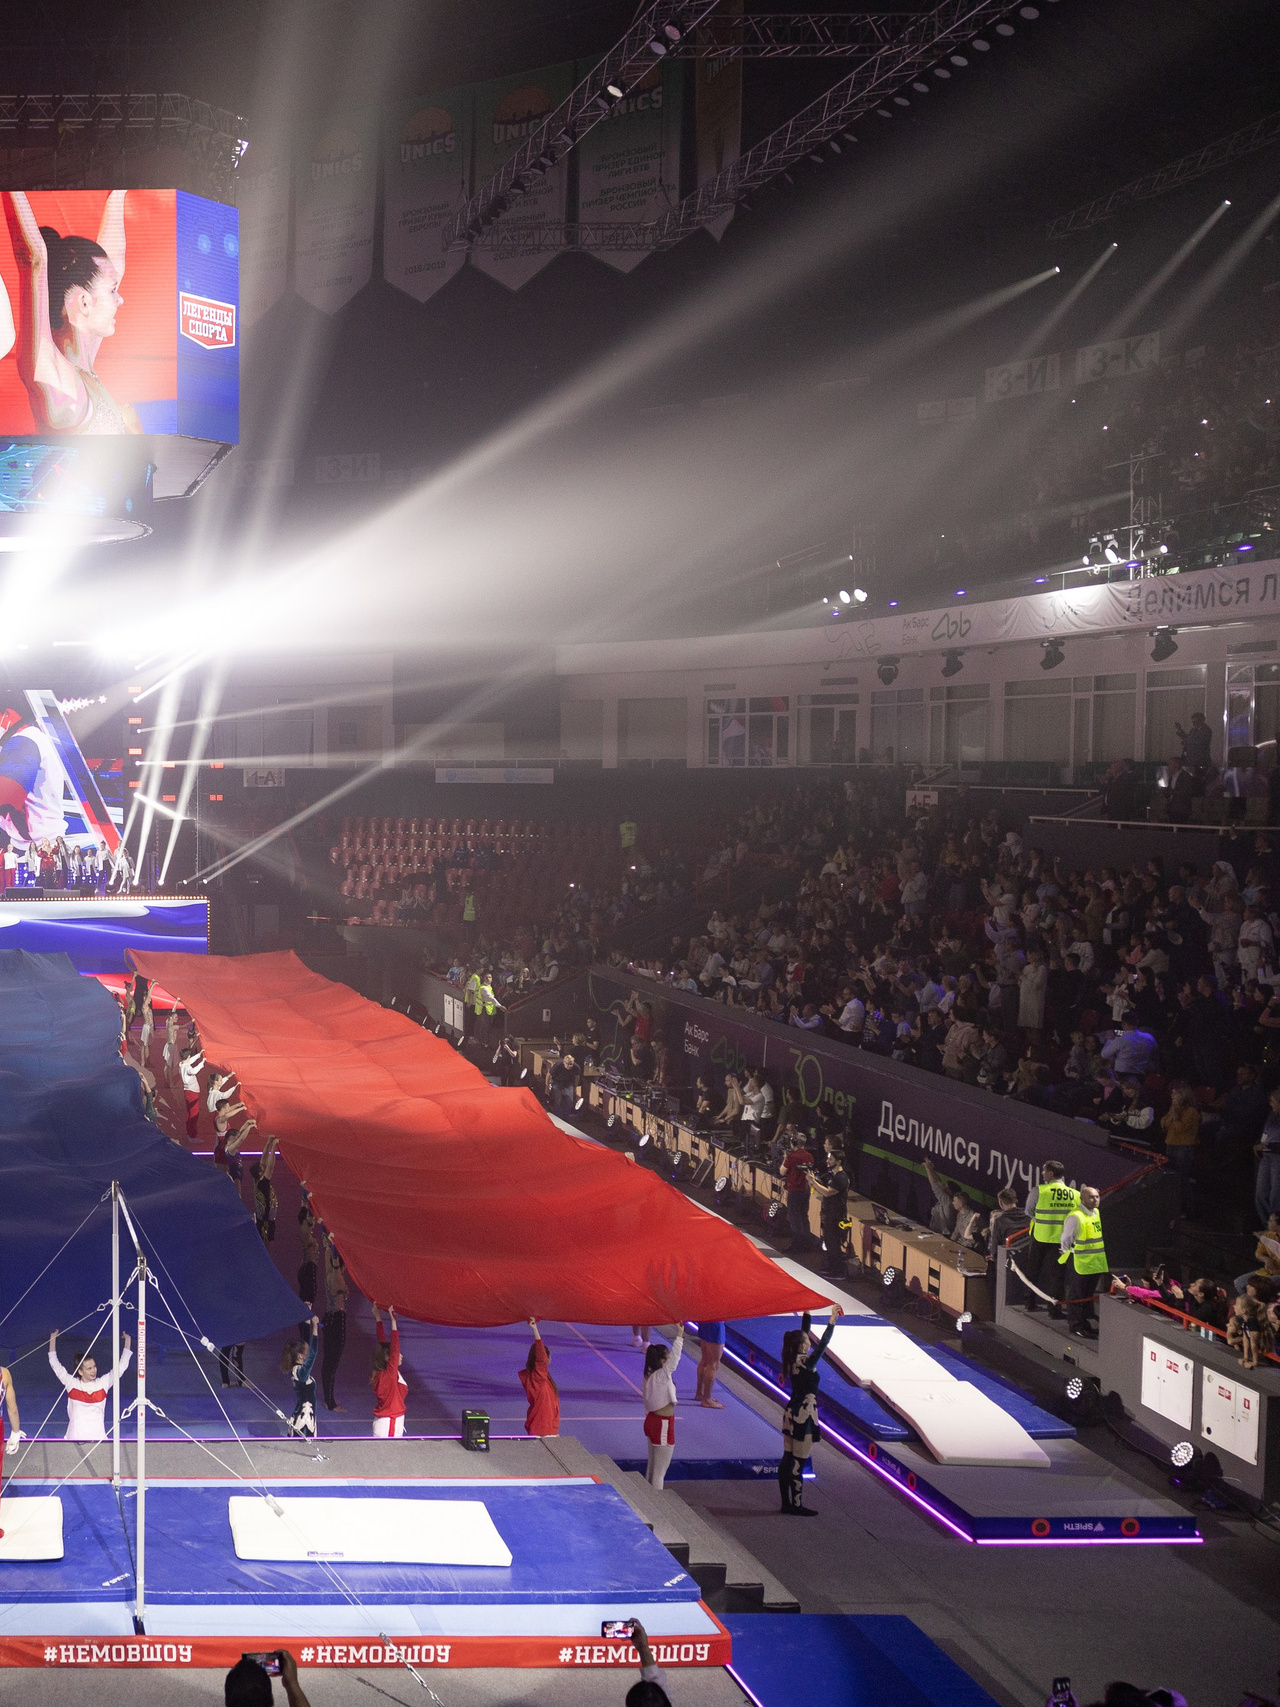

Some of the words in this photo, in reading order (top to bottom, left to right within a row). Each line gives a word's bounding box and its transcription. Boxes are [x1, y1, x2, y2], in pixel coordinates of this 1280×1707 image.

[601, 86, 663, 122] NICS
[400, 132, 456, 163] UNICS
[311, 153, 363, 181] UNICS
[183, 300, 233, 326] ЛЕГЕНДЫ
[189, 319, 228, 342] СПОРТА
[1122, 578, 1250, 622] Делимся
[684, 1021, 693, 1035] Ак
[693, 1025, 710, 1043] Барс
[684, 1039, 700, 1057] Банк
[789, 1048, 823, 1108] 30
[824, 1086, 857, 1119] лет
[877, 1101, 980, 1171] Делимся
[1050, 1188, 1075, 1201] 7990
[44, 1644, 193, 1663] #НЕМОВШОУ
[300, 1644, 451, 1664] #НЕМОВШОУ
